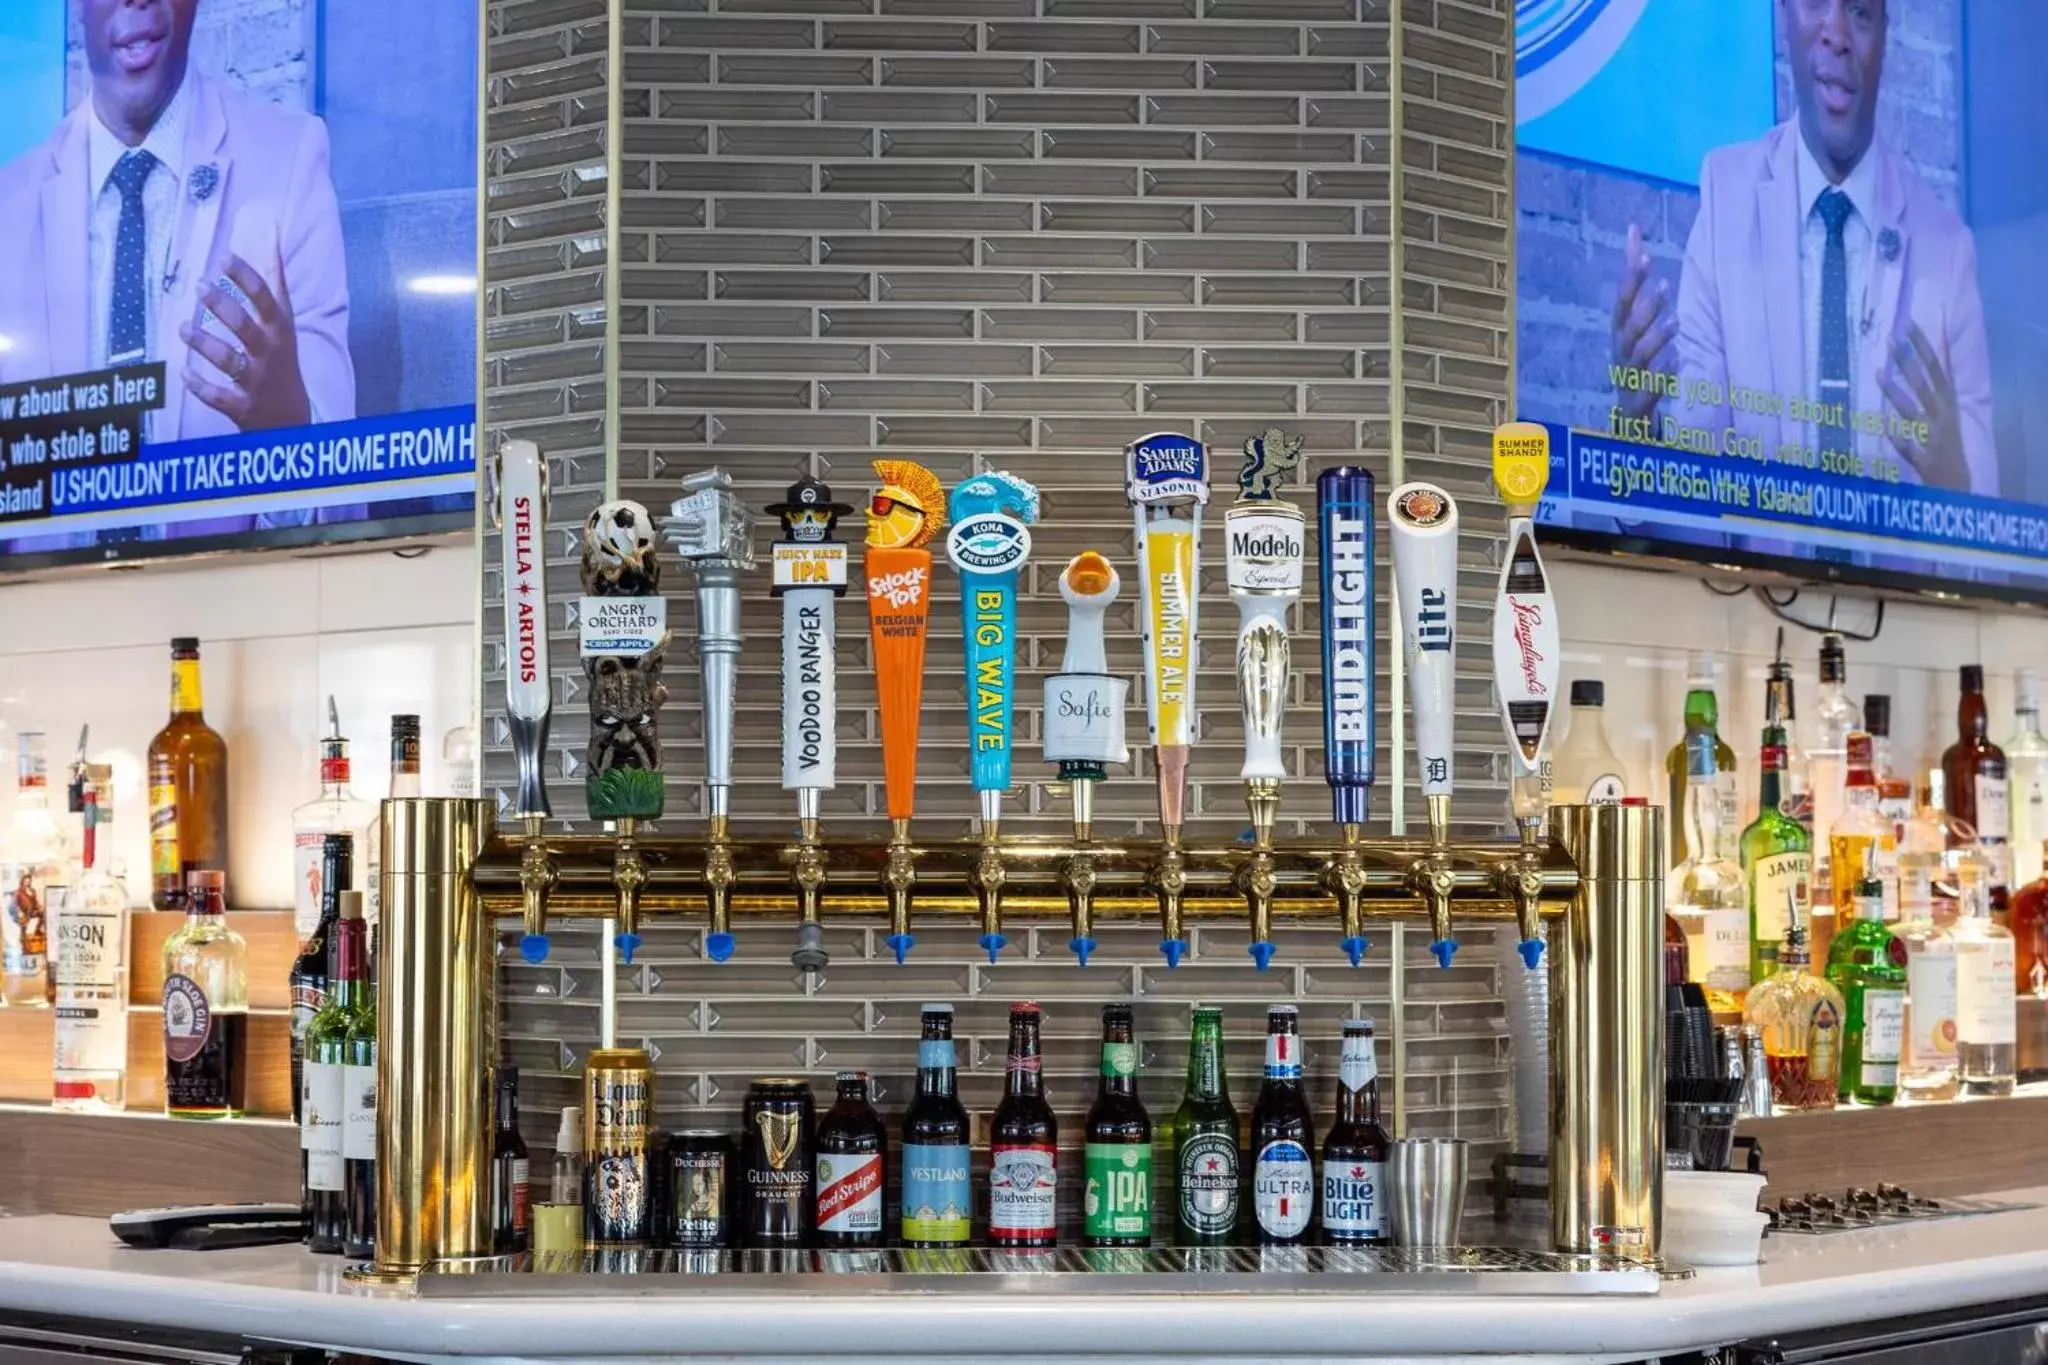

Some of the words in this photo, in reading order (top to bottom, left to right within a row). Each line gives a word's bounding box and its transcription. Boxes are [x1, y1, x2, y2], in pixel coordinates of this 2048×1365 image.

[19, 383, 70, 418] about
[73, 383, 109, 410] was
[114, 374, 156, 405] here
[1608, 364, 1680, 398] wanna
[1686, 378, 1723, 410] you
[1729, 376, 1783, 416] know
[1789, 394, 1846, 429] about
[1848, 408, 1886, 435] was
[1889, 408, 1929, 444] here
[10, 432, 46, 465] who
[50, 426, 96, 461] stole
[100, 422, 130, 455] the
[1139, 447, 1199, 463] SAMUEL
[1498, 439, 1545, 449] SUMMER
[1499, 448, 1543, 457] SHANDY
[1663, 416, 1717, 456] Demi
[1773, 436, 1816, 469] who
[1821, 447, 1865, 478] stole
[1870, 455, 1900, 483] the
[68, 458, 181, 504] SHOULDN'T
[183, 451, 235, 491] TAKE
[238, 441, 314, 486] ROCKS
[318, 434, 385, 477] HOME
[389, 425, 455, 468] FROM
[459, 422, 475, 461] H
[1144, 459, 1195, 476] ADAMS
[0, 478, 44, 513] sland
[1140, 483, 1199, 497] SEASONAL
[972, 522, 1004, 534] KONA
[1881, 495, 1920, 531] TAKE
[1923, 500, 1976, 541] ROCKS
[1977, 510, 2019, 547] HOME
[2020, 517, 2048, 550] FRO
[514, 497, 531, 576] STELLA
[1232, 532, 1300, 558] Modelo
[775, 549, 808, 560] JUICY
[962, 551, 1006, 565] BREWING
[791, 560, 829, 582] IPA
[869, 567, 928, 597] SHOCK
[1332, 514, 1366, 642] LIGHT
[599, 604, 646, 616] ANGRY
[884, 586, 922, 609] TOP
[588, 616, 658, 628] ORCHARD
[875, 614, 924, 625] BELGIAN
[975, 590, 1004, 648] BIG
[1160, 572, 1184, 663] SUMMER
[1417, 587, 1451, 654] Lite
[518, 602, 536, 684] ARTOIS
[588, 640, 618, 648] CRISP
[618, 639, 651, 648] APPLE
[881, 626, 918, 637] WHITE
[801, 606, 821, 688] RANGER
[1161, 667, 1184, 705] ALE
[1334, 647, 1366, 742] BUD
[976, 661, 1004, 753] WAVE
[1058, 689, 1112, 728] Sofie
[799, 693, 821, 769] VOODOO
[1767, 859, 1809, 878] JAME
[182, 980, 204, 1007] SLOE
[194, 1009, 207, 1034] GIN
[595, 1078, 648, 1107] Liquid
[596, 1104, 648, 1126] Death
[675, 1157, 721, 1168] DUCHESSE
[747, 1169, 810, 1183] GUINNESS
[1181, 1175, 1239, 1189] Heineken
[1257, 1180, 1312, 1194] ULTRA
[1326, 1176, 1374, 1201] Blue
[818, 1190, 838, 1217] Red
[838, 1171, 877, 1199] Stripe
[994, 1191, 1052, 1203] Budweiser
[1107, 1171, 1148, 1213] IPA
[1326, 1201, 1374, 1220] LIGHT
[678, 1218, 716, 1230] Petite
